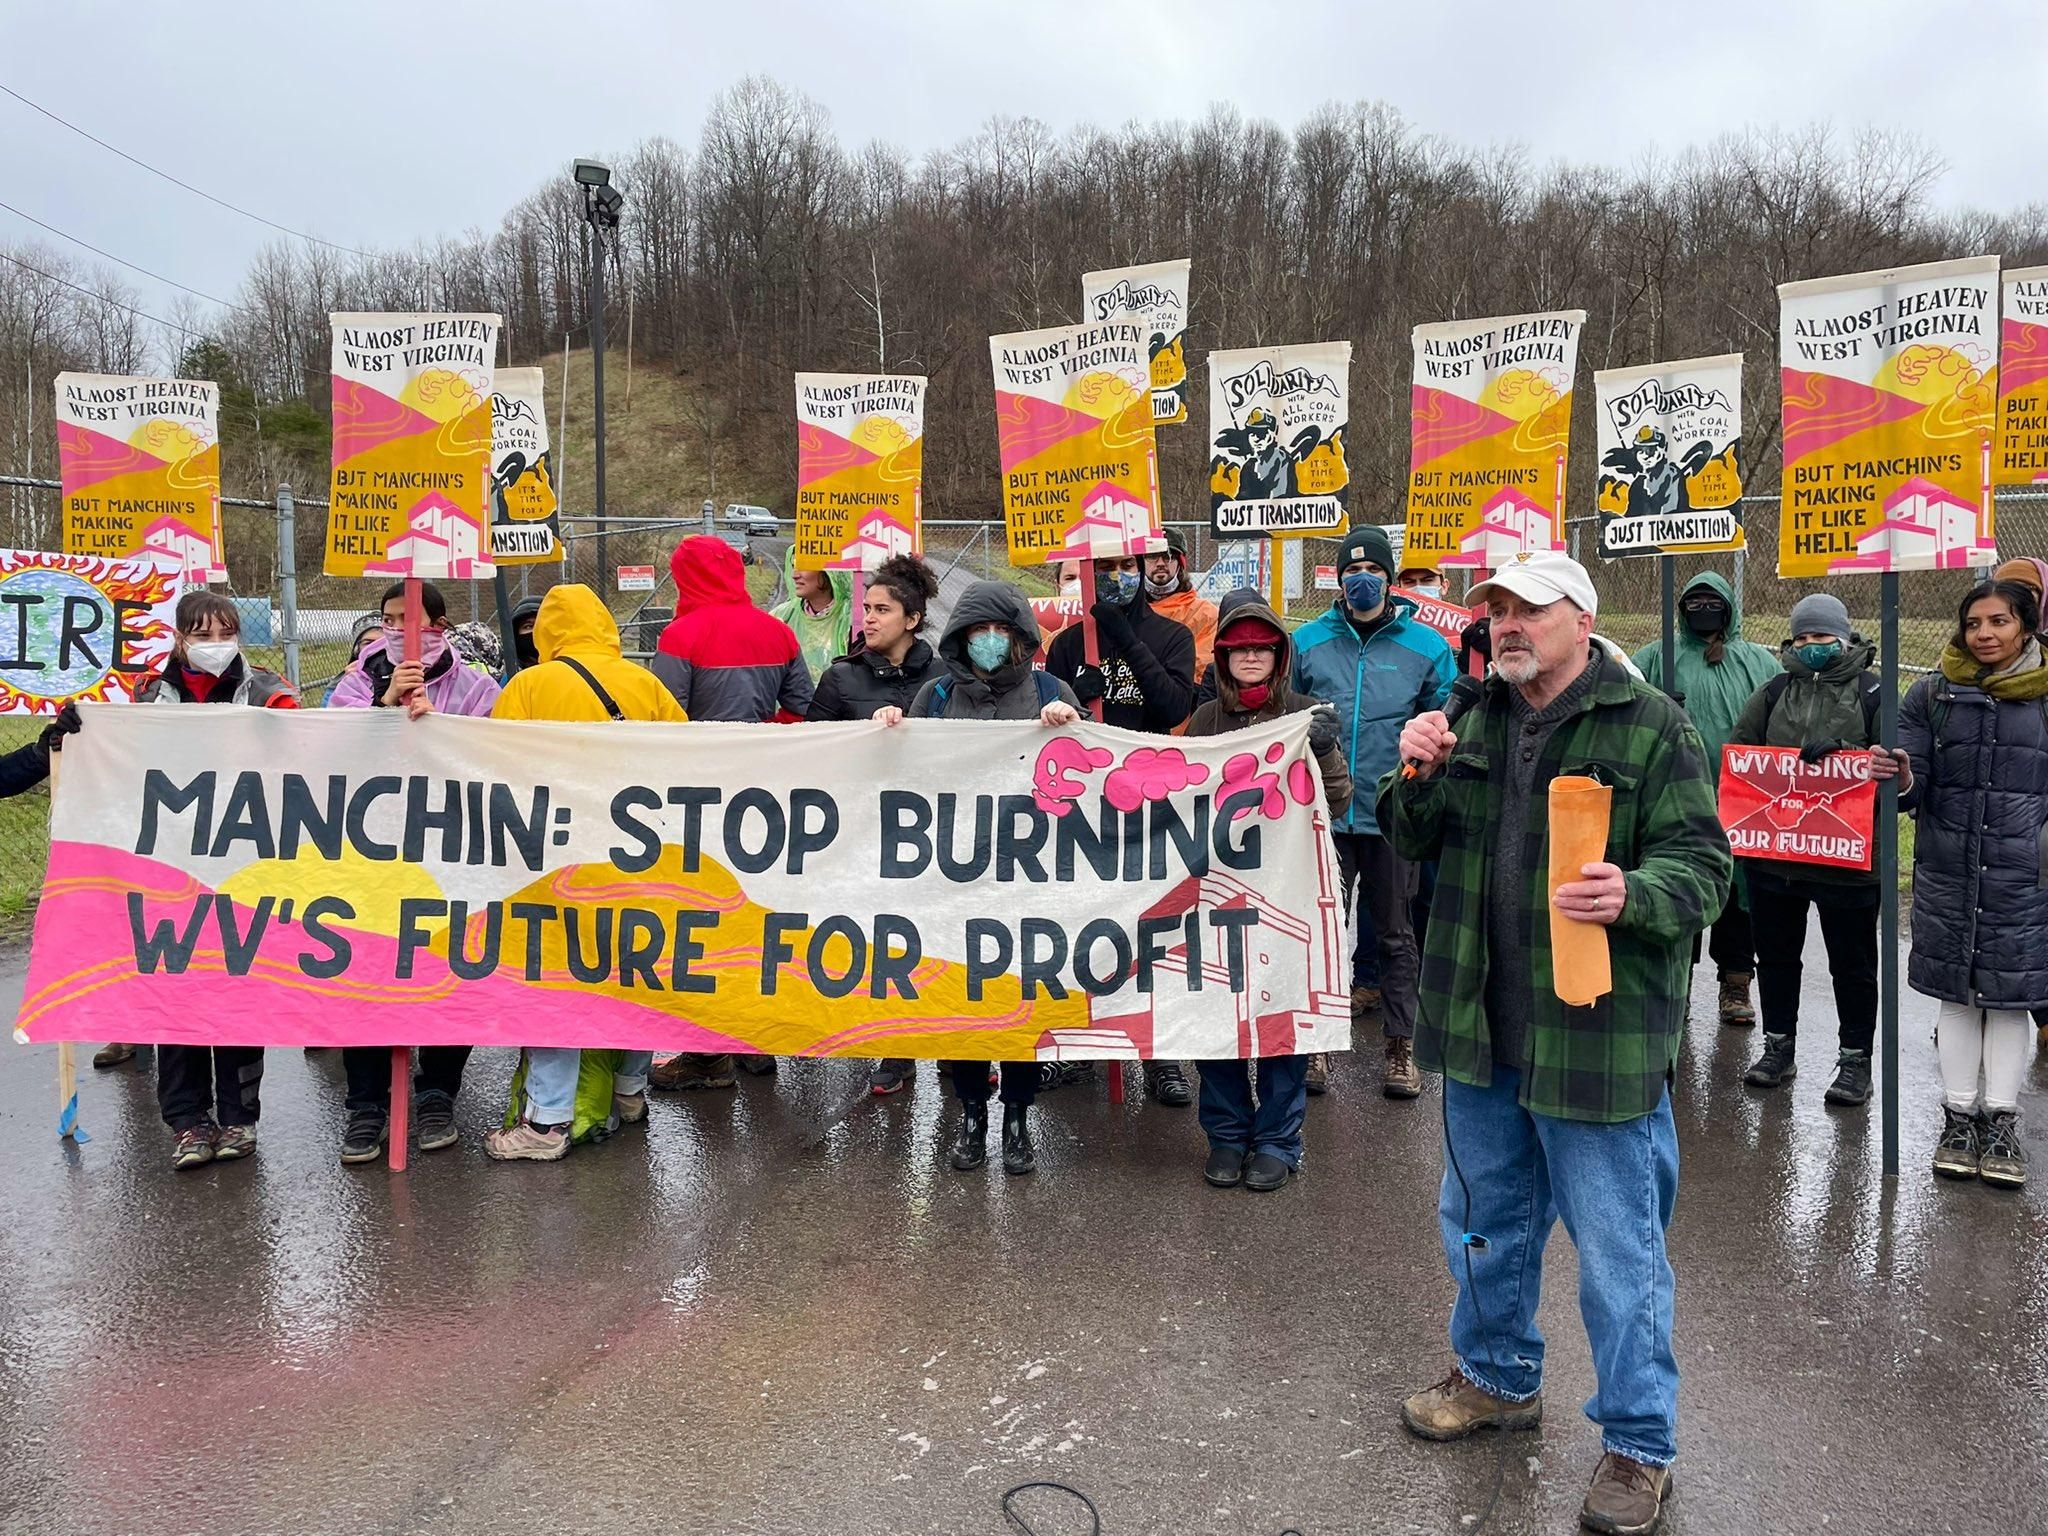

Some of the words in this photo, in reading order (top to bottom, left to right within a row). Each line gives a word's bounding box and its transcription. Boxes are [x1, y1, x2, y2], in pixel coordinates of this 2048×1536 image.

[1098, 286, 1170, 321] SOLIDARITY
[1794, 304, 1889, 337] ALMOST
[1897, 287, 1989, 318] HEAVEN
[1157, 313, 1178, 321] COAL
[342, 326, 416, 349] ALMOST
[423, 320, 492, 343] HEAVEN
[1424, 331, 1496, 357] ALMOST
[1502, 319, 1575, 344] HEAVEN
[1797, 338, 1862, 361] WEST
[1872, 314, 1981, 349] VIRGINIA
[1002, 336, 1070, 366] ALMOST
[1077, 325, 1142, 350] HEAVEN
[344, 350, 395, 371] WEST
[403, 344, 484, 367] VIRGINIA
[1155, 360, 1170, 368] IT'S
[1424, 359, 1474, 378] WEST
[1482, 343, 1564, 370] VIRGINIA
[1004, 366, 1053, 385] WEST
[1060, 348, 1139, 376] VIRGINIA
[1156, 367, 1174, 375] TIME
[67, 385, 138, 403] ALMOST
[145, 383, 211, 402] HEAVEN
[804, 384, 861, 402] ALMOST
[867, 380, 920, 397] HEAVEN
[1231, 366, 1324, 407] SOLIDARITY
[1288, 394, 1305, 403] WITH
[1617, 385, 1715, 427] SOLIDARITY
[2007, 399, 2039, 413] BUT
[69, 403, 119, 421] WEST
[127, 401, 206, 419] VIRGINIA
[806, 402, 845, 418] WEST
[851, 398, 914, 415] VIRGINIA
[1282, 405, 1303, 418] ALL
[1309, 401, 1337, 413] COAL
[1677, 411, 1695, 419] WITH
[1284, 414, 1335, 426] WORKERS
[1671, 421, 1693, 433] ALL
[1700, 417, 1729, 427] COAL
[510, 428, 537, 439] COAL
[1673, 430, 1727, 442] WORKERS
[2005, 435, 2020, 448] IT
[1310, 460, 1329, 468] IT'S
[1795, 464, 1834, 483] BUT
[1844, 454, 1962, 480] MANCHIN'S
[374, 472, 464, 489] MANCHIN'S
[1010, 472, 1038, 488] BUT
[1045, 462, 1130, 486] MANCHIN'S
[1311, 469, 1334, 477] TIME
[1415, 472, 1442, 486] BUT
[1450, 469, 1539, 486] MANCHIN'S
[1702, 475, 1722, 483] IT'S
[1703, 483, 1727, 491] TIME
[336, 492, 397, 509] MAKING
[520, 495, 541, 503] TIME
[801, 492, 825, 504] BUT
[830, 493, 899, 505] MANCHIN'S
[1010, 489, 1070, 508] MAKING
[1413, 492, 1472, 507] MAKING
[1794, 485, 1876, 507] MAKING
[71, 498, 100, 512] BUT
[108, 500, 195, 513] MANCHIN'S
[1222, 505, 1254, 526] JUST
[1258, 502, 1336, 525] TRANSITION
[72, 516, 133, 529] MAKING
[800, 509, 848, 520] MAKING
[1012, 512, 1028, 527] IT
[1032, 510, 1066, 524] LIKE
[1410, 513, 1426, 527] IT
[1431, 513, 1465, 527] LIKE
[1794, 511, 1813, 529] IT
[1822, 509, 1866, 527] LIKE
[334, 515, 348, 530] IT
[355, 516, 390, 532] LIKE
[800, 525, 811, 537] IT
[816, 525, 843, 538] LIKE
[1610, 522, 1643, 544] JUST
[1649, 517, 1730, 541] TRANSITION
[72, 534, 85, 547] IT
[93, 534, 127, 547] LIKE
[334, 535, 383, 556] HELL
[800, 540, 837, 555] HELL
[1014, 529, 1062, 549] HELL
[1410, 532, 1456, 549] HELL
[1795, 533, 1858, 554] HELL
[1728, 752, 1771, 774] WV
[1781, 799, 1804, 810] FOR
[136, 769, 572, 872] MANCHIN:
[610, 785, 840, 875] STOP
[879, 788, 1264, 883] BURNING
[1729, 830, 1771, 849] OUR
[1779, 833, 1863, 859] FUTURE
[127, 892, 356, 977] WV'S
[395, 898, 720, 993] FUTURE
[760, 911, 923, 1000] FOR
[966, 908, 1260, 1001] PROFIT
